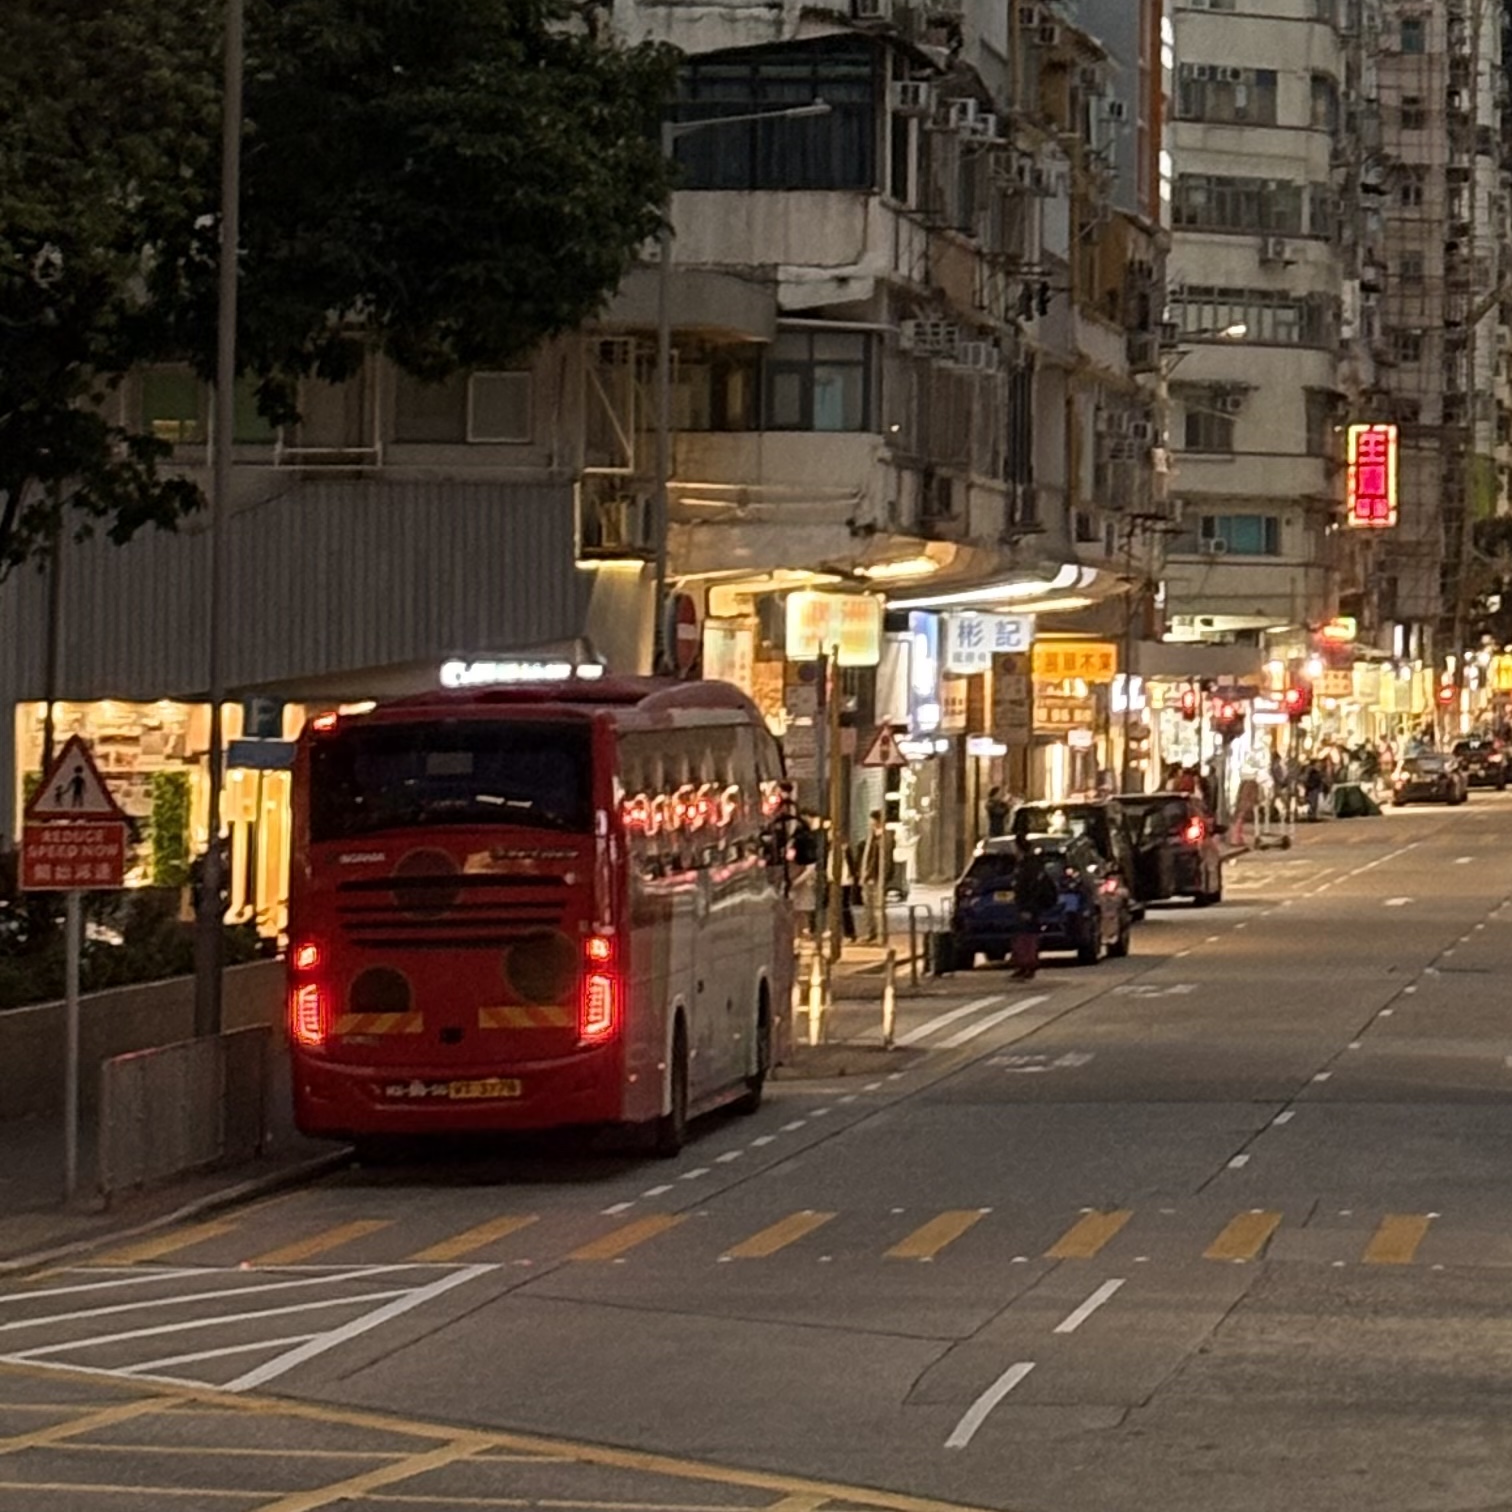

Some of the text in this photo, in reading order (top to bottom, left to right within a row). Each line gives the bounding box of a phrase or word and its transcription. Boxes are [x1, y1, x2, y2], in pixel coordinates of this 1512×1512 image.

[957, 619, 1022, 648] 彬記
[42, 829, 104, 843] REDUCE
[27, 843, 119, 858] SPEED NOW
